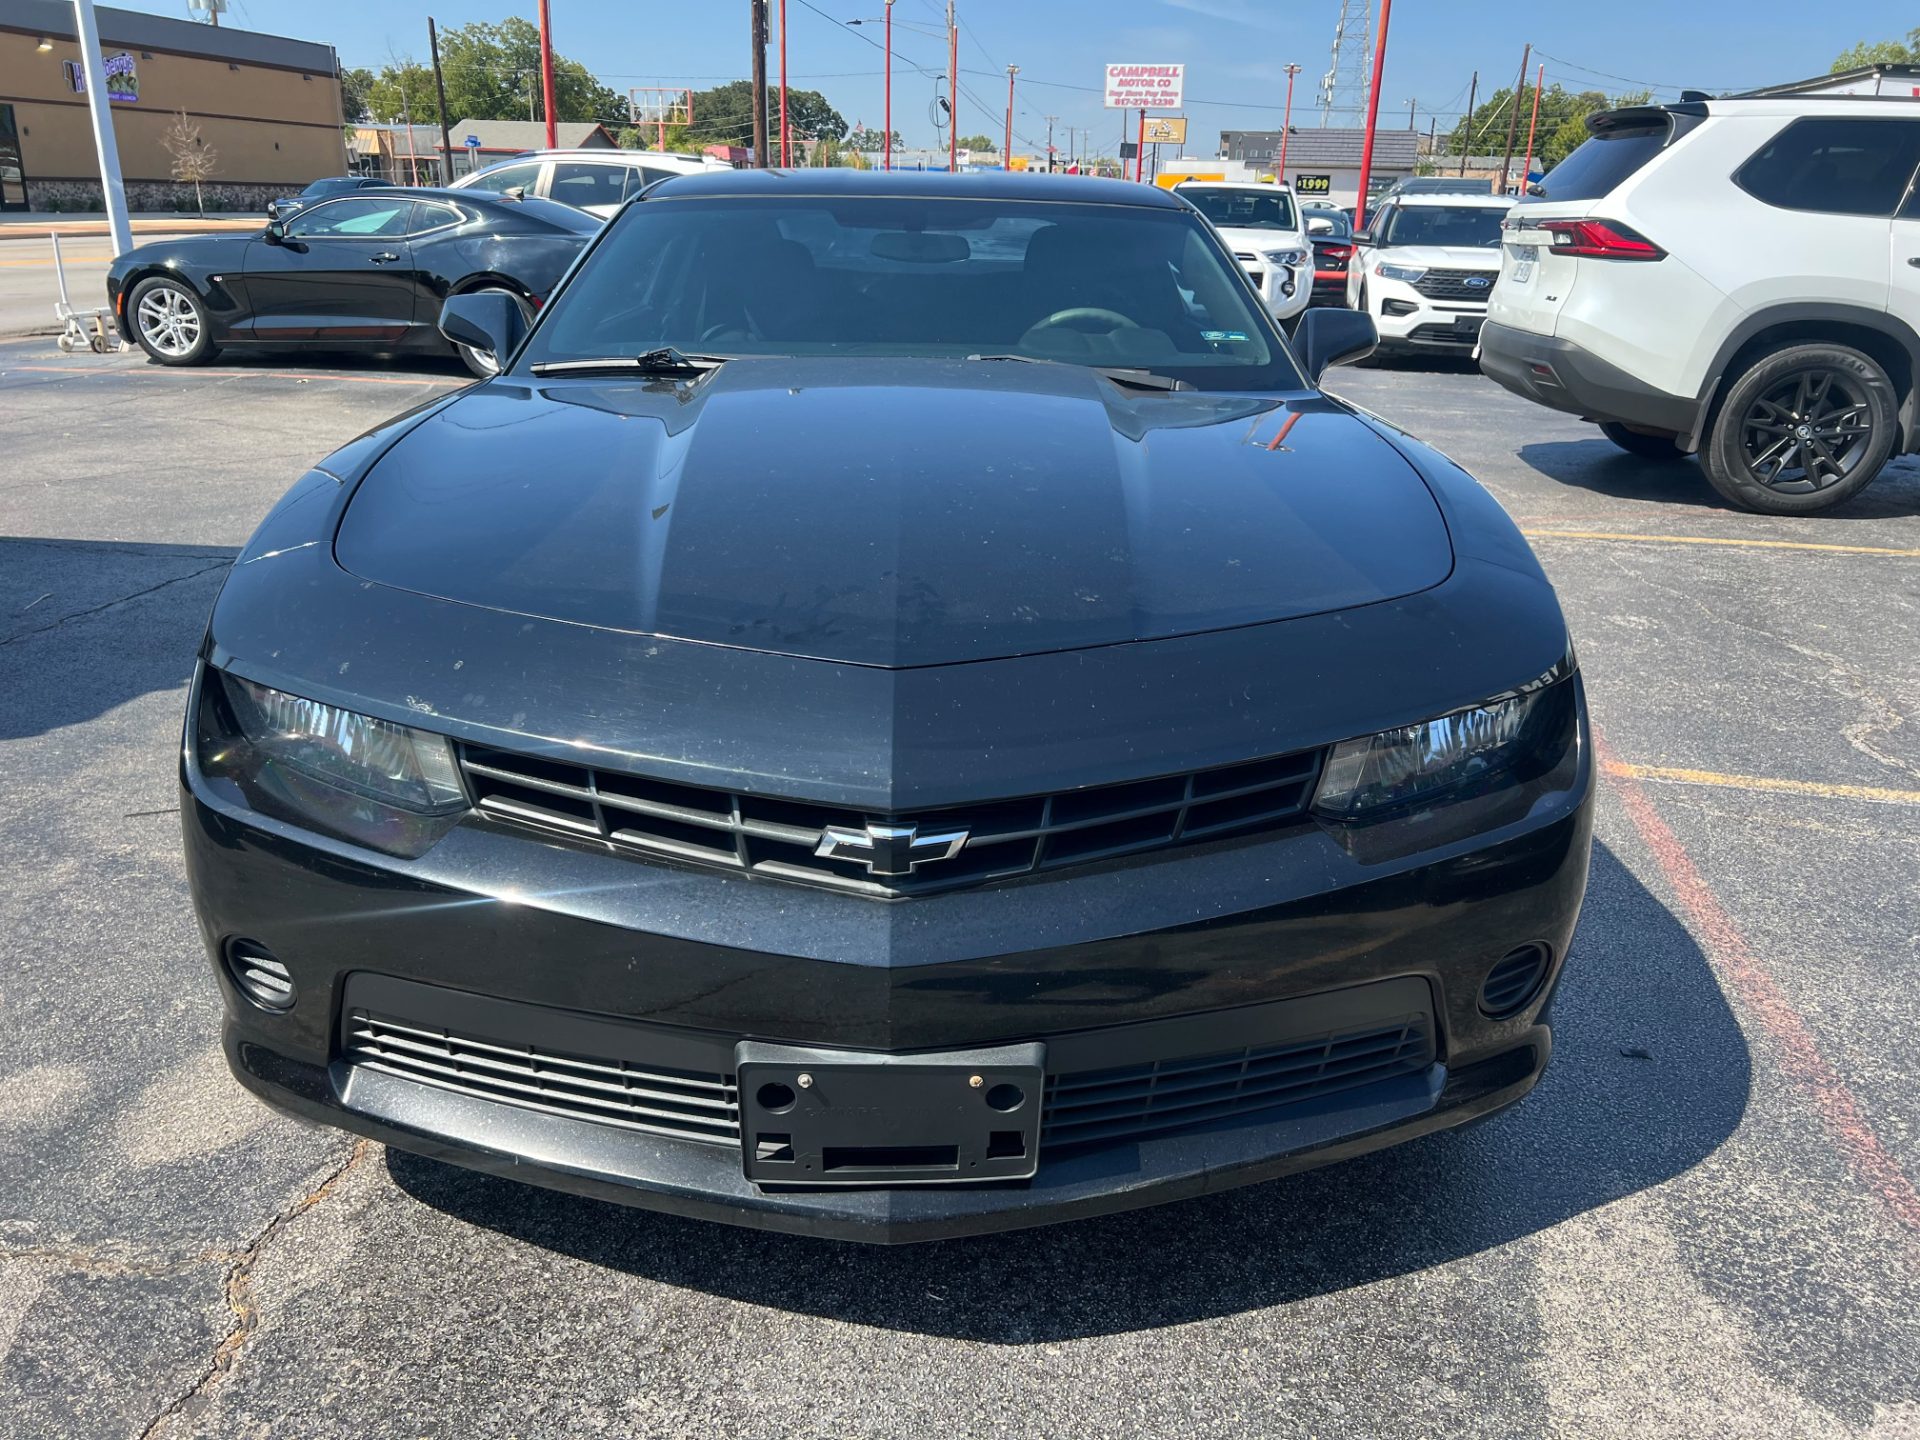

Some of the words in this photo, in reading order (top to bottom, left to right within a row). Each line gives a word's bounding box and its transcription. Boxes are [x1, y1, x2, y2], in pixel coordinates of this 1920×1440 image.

[73, 52, 134, 92] Hberry's
[1109, 66, 1179, 77] CAMPBELL
[1118, 78, 1155, 87] MOTOR
[1157, 79, 1171, 87] CO
